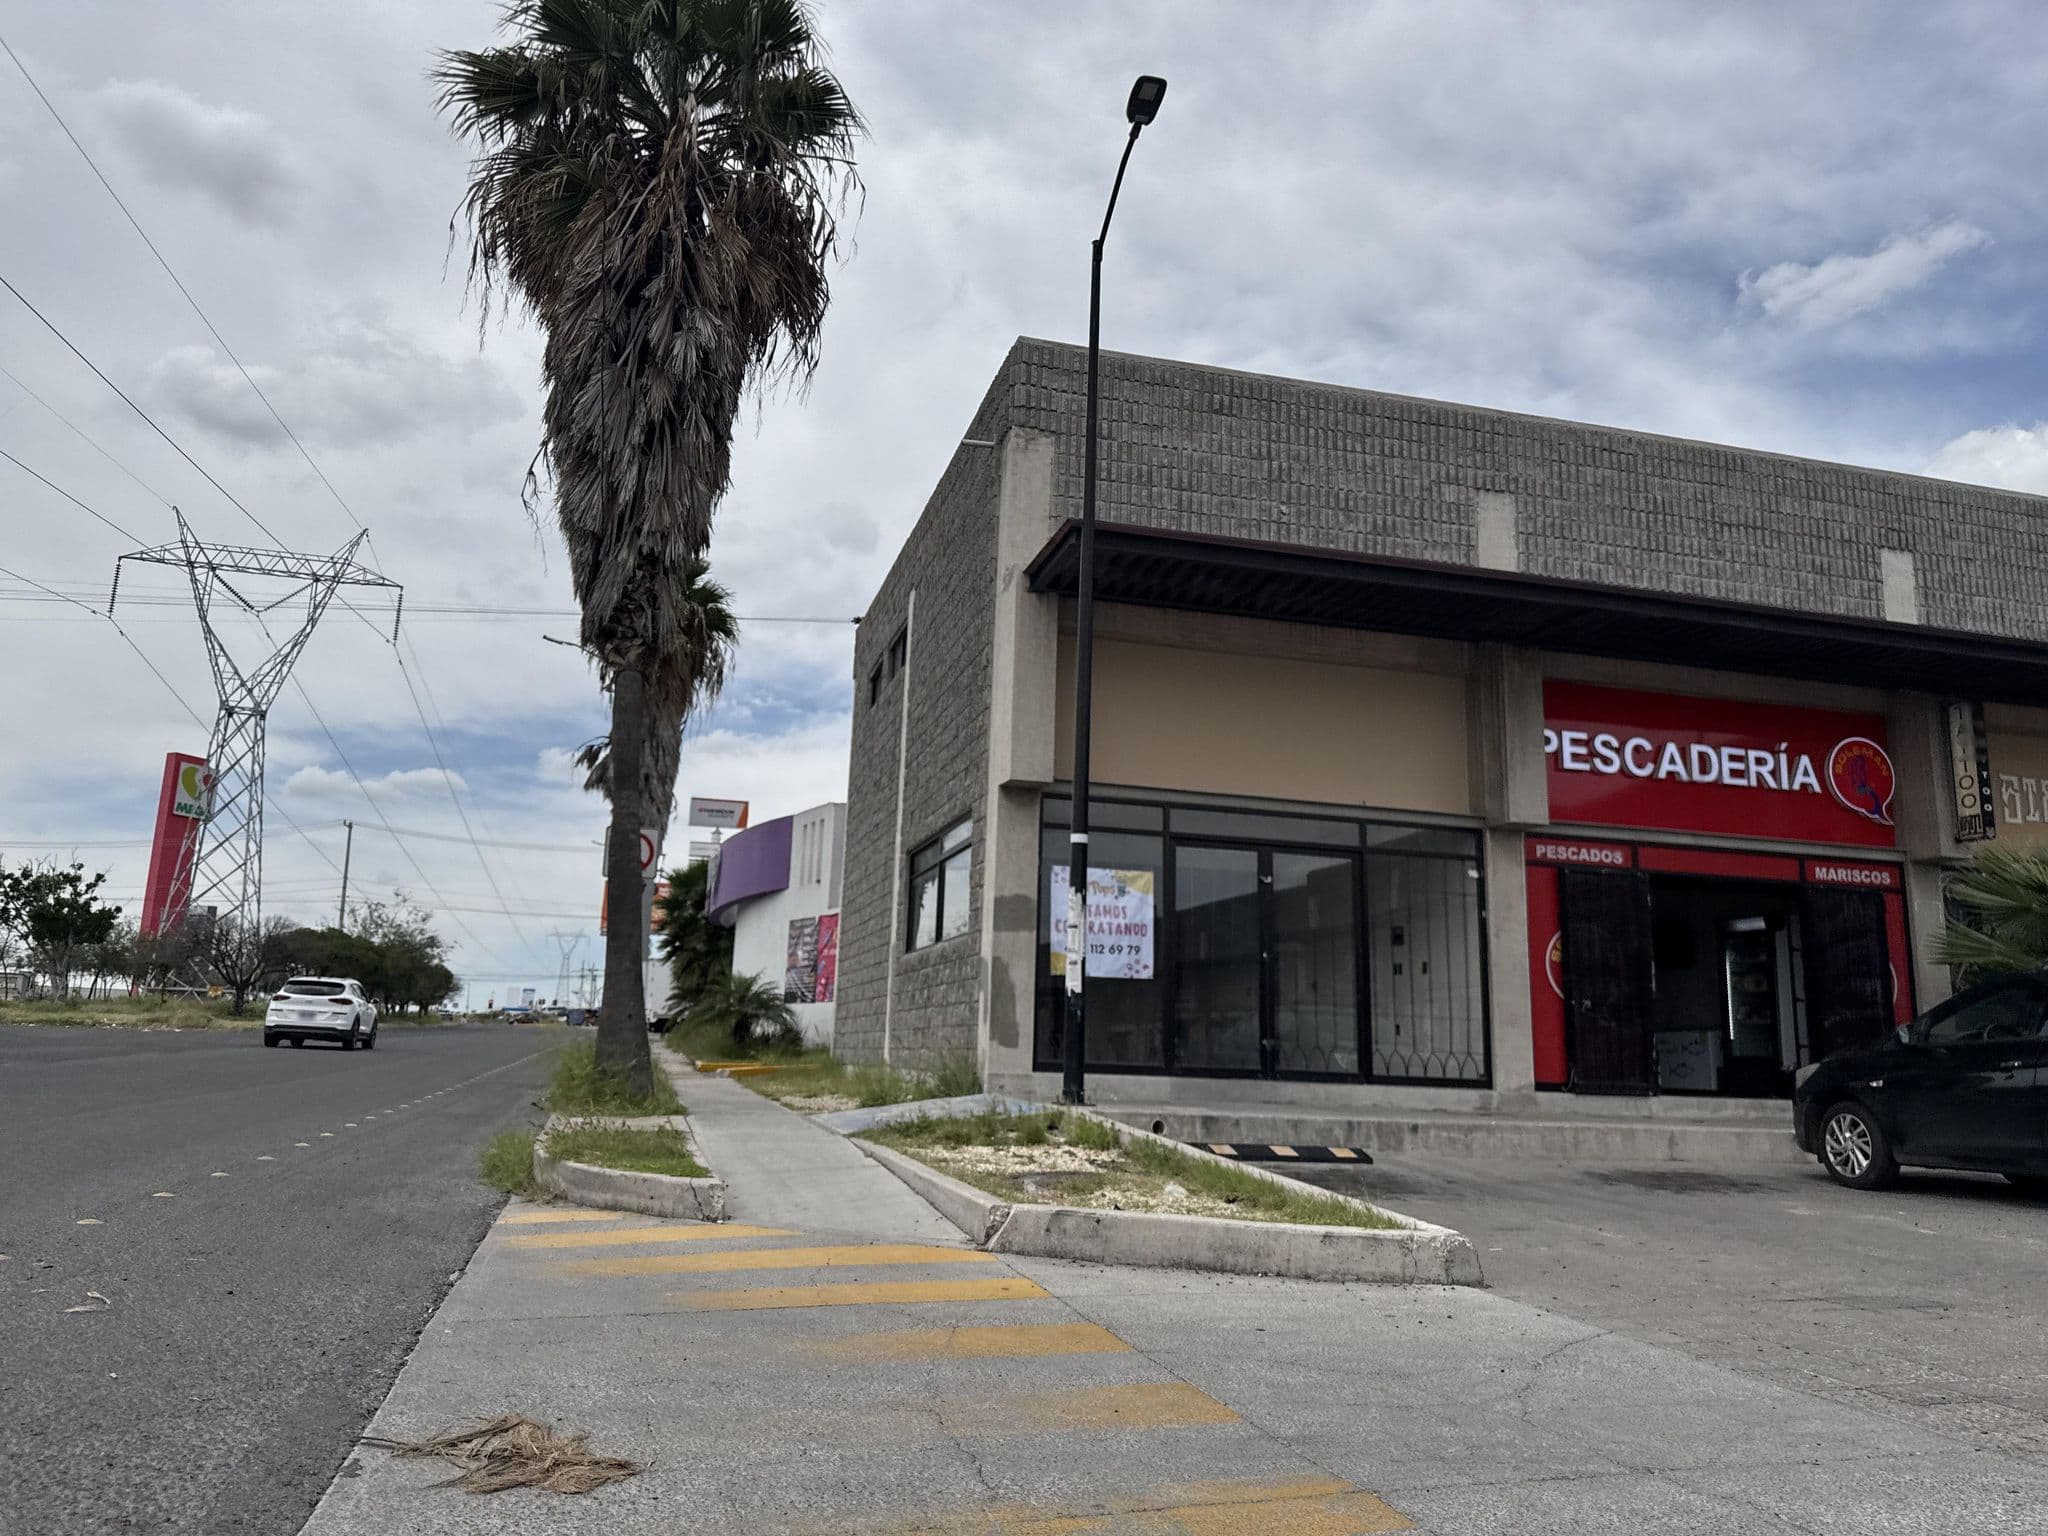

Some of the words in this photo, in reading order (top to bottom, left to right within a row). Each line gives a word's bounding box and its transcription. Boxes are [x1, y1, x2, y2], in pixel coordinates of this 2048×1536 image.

[1535, 844, 1623, 865] PESCADOS
[1814, 867, 1890, 885] MARISCOS
[1087, 904, 1127, 920] TAMOS
[1055, 918, 1147, 937] CORATANDO
[1090, 944, 1105, 954] 112
[1108, 944, 1124, 955] 69
[1127, 945, 1141, 955] 79
